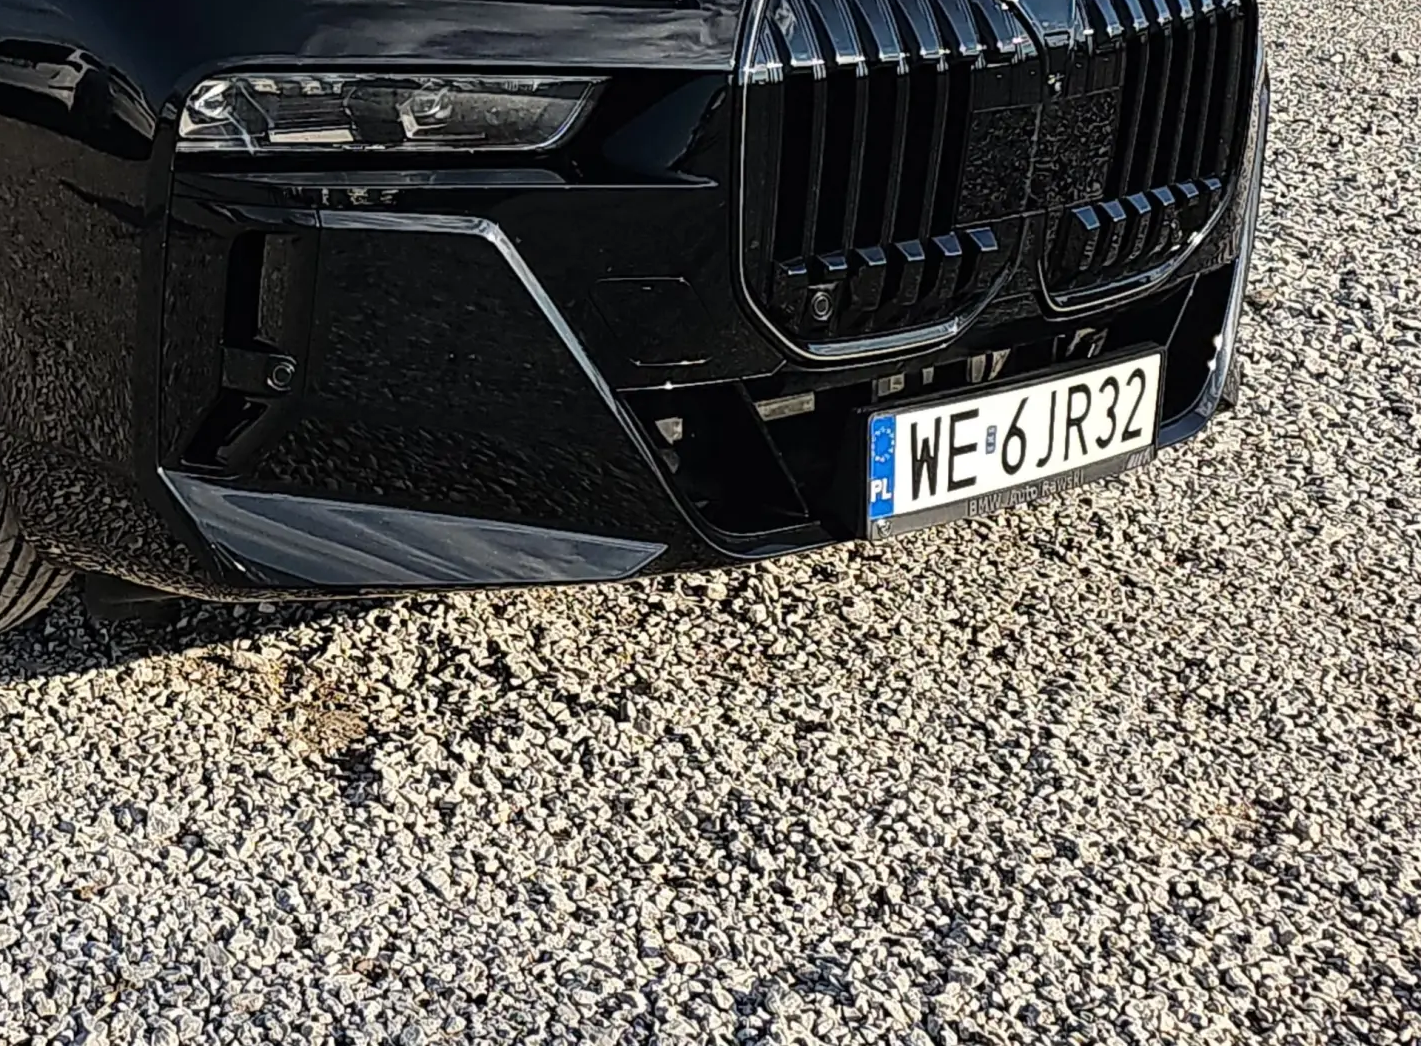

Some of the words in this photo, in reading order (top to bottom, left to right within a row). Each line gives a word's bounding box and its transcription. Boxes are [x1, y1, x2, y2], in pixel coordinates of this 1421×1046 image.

[911, 408, 980, 501] WE
[1001, 368, 1146, 476] 6JR32
[870, 478, 892, 502] PL
[968, 493, 1002, 517] BMW
[1009, 485, 1038, 506] Auto
